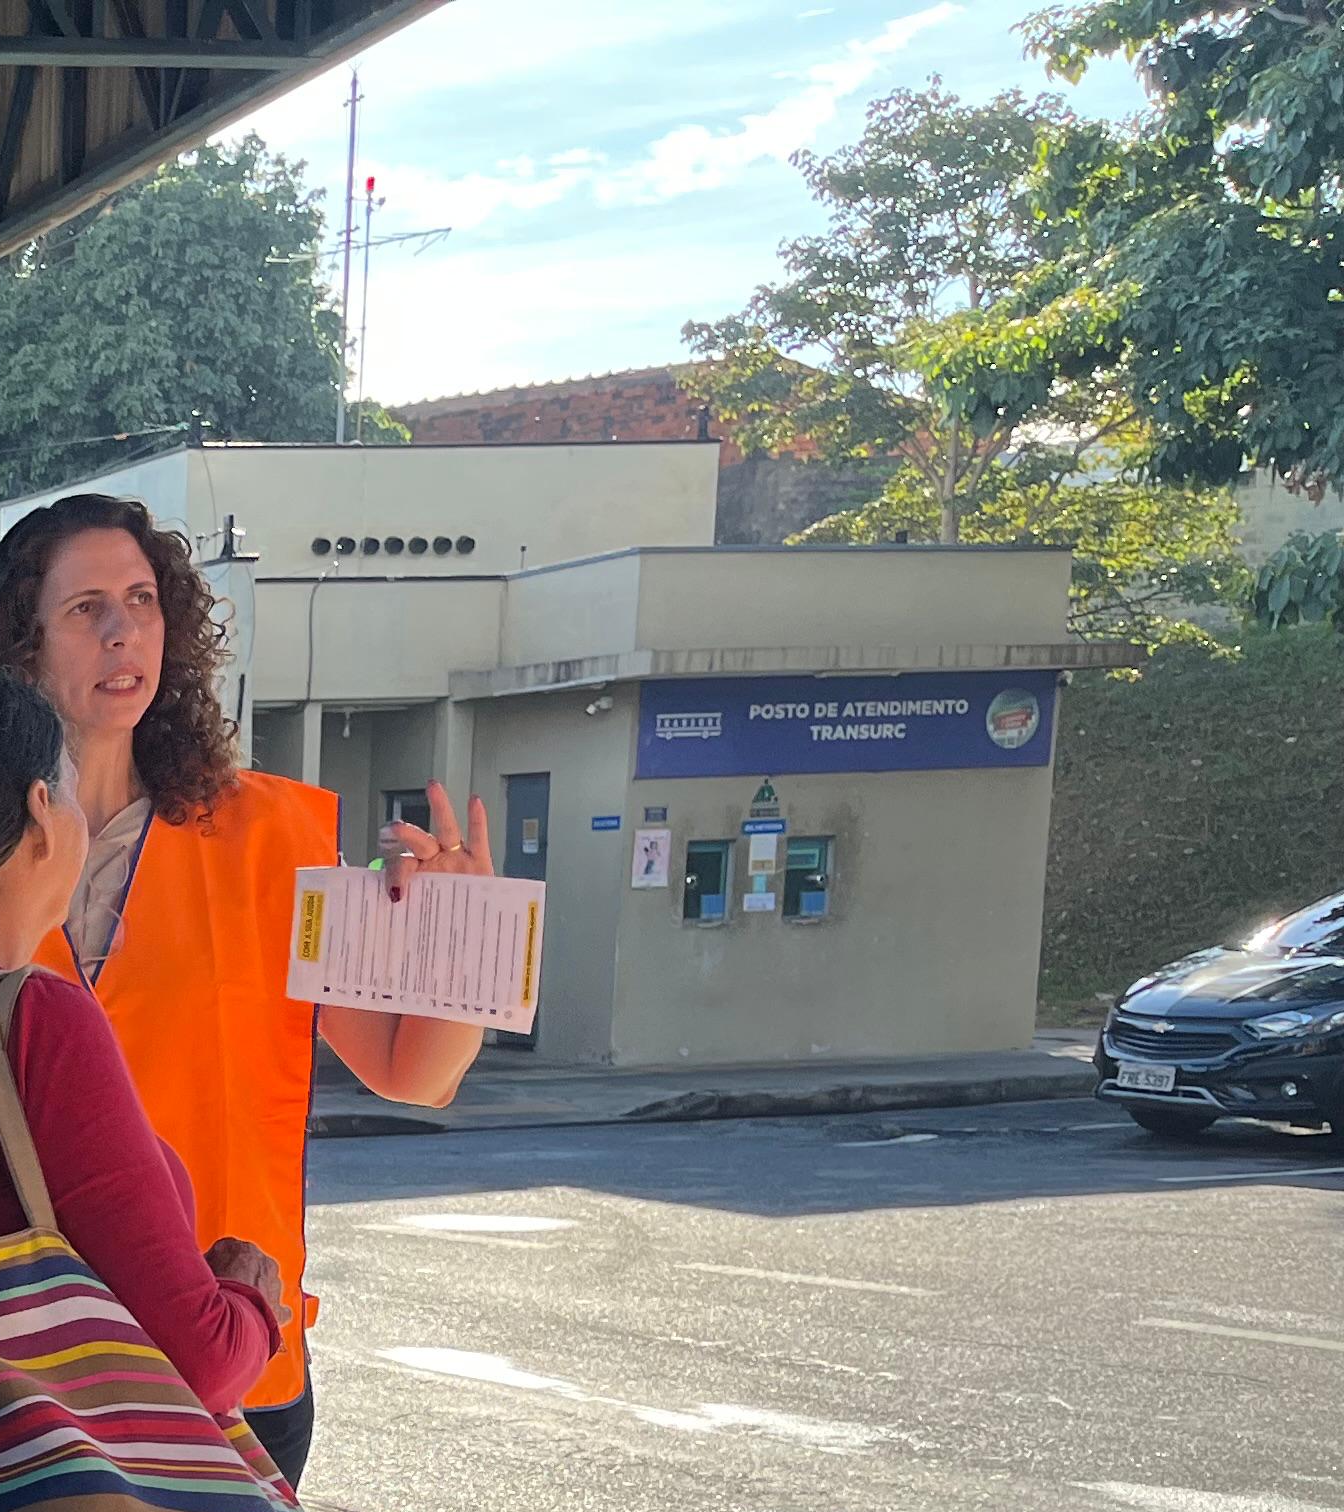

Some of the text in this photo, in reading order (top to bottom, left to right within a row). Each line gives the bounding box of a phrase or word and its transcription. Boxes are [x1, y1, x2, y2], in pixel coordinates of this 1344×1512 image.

[749, 699, 969, 720] POSTO DE ATENDIMENTO
[810, 723, 906, 741] TRANSURC
